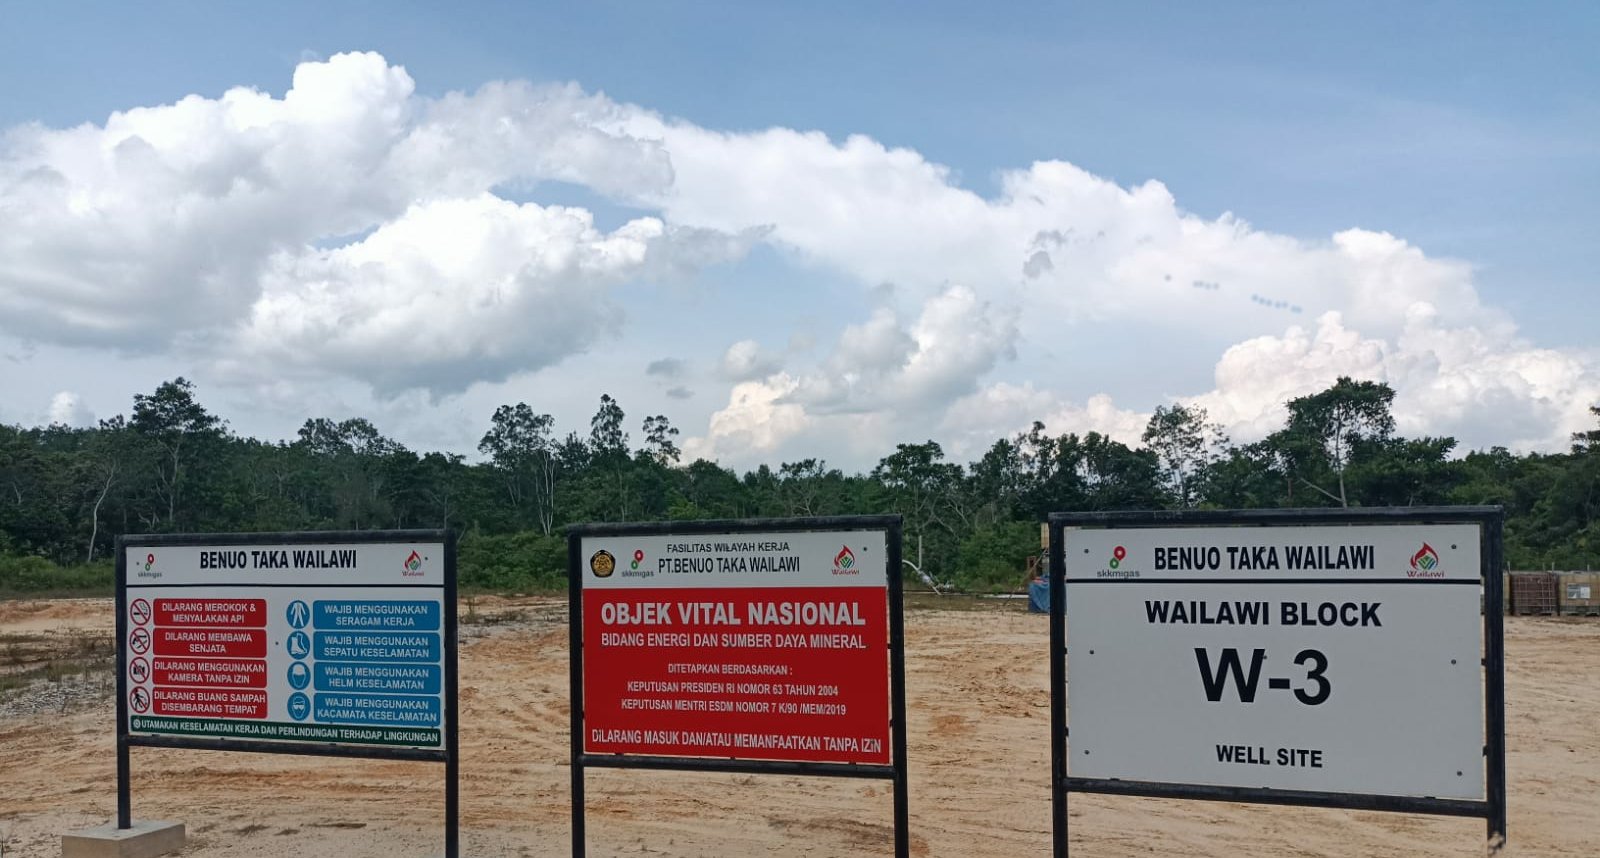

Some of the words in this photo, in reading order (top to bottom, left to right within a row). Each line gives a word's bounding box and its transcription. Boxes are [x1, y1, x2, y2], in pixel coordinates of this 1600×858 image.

[667, 543, 712, 553] FASILITAS
[714, 542, 755, 552] WILAYAH
[758, 542, 790, 551] KERJA
[200, 551, 246, 568] BENUO
[252, 551, 288, 568] TAKA
[293, 550, 356, 568] WAILAWI
[1155, 547, 1220, 570] BENUO
[1227, 546, 1279, 570] TAKA
[1285, 545, 1374, 569] WAILAWI
[659, 558, 713, 573] PT.BENUO
[716, 557, 747, 573] TAKA
[750, 557, 800, 572] WAILAWI
[622, 570, 654, 578] skkmigas
[1097, 570, 1140, 579] skkmigas
[205, 604, 247, 612] MEROKOK
[324, 605, 352, 614] WAJIB
[354, 605, 428, 615] MENGGUNAKAN
[601, 602, 672, 625] OBJEK
[677, 602, 741, 625] VITAL
[748, 602, 866, 625] NASIONAL
[1145, 601, 1269, 625] WAILAWI
[1281, 602, 1382, 627] BLOCK
[336, 617, 381, 626] SERAGAM
[384, 617, 415, 626] KERJA
[208, 634, 252, 642] MEMBAWA
[324, 636, 352, 645] WAJIB
[354, 636, 428, 646] MENGGUNAKAN
[602, 632, 644, 646] BIDANG
[648, 633, 690, 646] ENERGI
[694, 634, 718, 646] DAN
[722, 634, 772, 648] SUMBER
[776, 634, 807, 648] DAYA
[810, 635, 866, 648] MINERAL
[189, 644, 226, 653] SENJATA
[324, 648, 358, 656] SEPATU
[360, 648, 429, 658] KESELAMATAN
[154, 662, 195, 670] DILARANG
[198, 663, 264, 672] MENGGUNAKAN
[325, 667, 352, 676] WAJIB
[355, 668, 429, 678] MENGGUNAKAN
[668, 664, 719, 674] DITETAPKAN
[722, 664, 787, 675] BERDASARKAN
[168, 674, 203, 682] KAMERA
[205, 674, 232, 683] TANPA
[234, 675, 249, 684] IZIN
[1194, 648, 1331, 705] W-3
[329, 679, 353, 687] HELM
[356, 679, 424, 689] KESELAMATAN
[628, 682, 678, 692] KEPUTUSAN
[681, 682, 724, 693] PRESIDEN
[726, 683, 734, 693] RI
[737, 684, 770, 694] NOMOR
[773, 684, 782, 694] 63
[785, 685, 816, 695] TAHUN
[818, 685, 838, 696] 2004
[154, 691, 195, 700] DILARANG
[198, 692, 227, 701] BUANG
[230, 694, 265, 703] SAMPAH
[162, 703, 222, 712] DISEMBARANG
[225, 705, 257, 714] TEMPAT
[325, 698, 352, 707] WAJIB
[355, 699, 428, 710] MENGGUNAKAN
[622, 699, 672, 709] KEPUTUSAN
[675, 700, 706, 711] MENTRI
[709, 701, 733, 711] ESDM
[736, 702, 769, 712] NOMOR
[771, 703, 776, 713] 7
[779, 703, 797, 713] K/90
[800, 703, 846, 715] /MEM/2019
[317, 710, 366, 719] KACAMATA
[368, 711, 436, 722] KESELAMATAN
[142, 721, 178, 730] UTAMAKAN
[180, 722, 233, 732] KESELAMATAN
[235, 724, 259, 733] KERJA
[261, 725, 277, 734] DAN
[279, 725, 338, 738] PERLINDUNGAN
[340, 730, 382, 740] TERHADAP
[384, 732, 438, 742] LINGKUNGAN
[592, 729, 641, 743] DILARANG
[644, 730, 680, 745] MASUK
[682, 732, 731, 746] DAN/ATAU
[735, 733, 820, 750] MEMANFAATKAN
[824, 736, 858, 752] TANPA
[862, 738, 881, 753] IZIN
[1216, 745, 1270, 765] WELL
[1277, 748, 1323, 768] SITE
